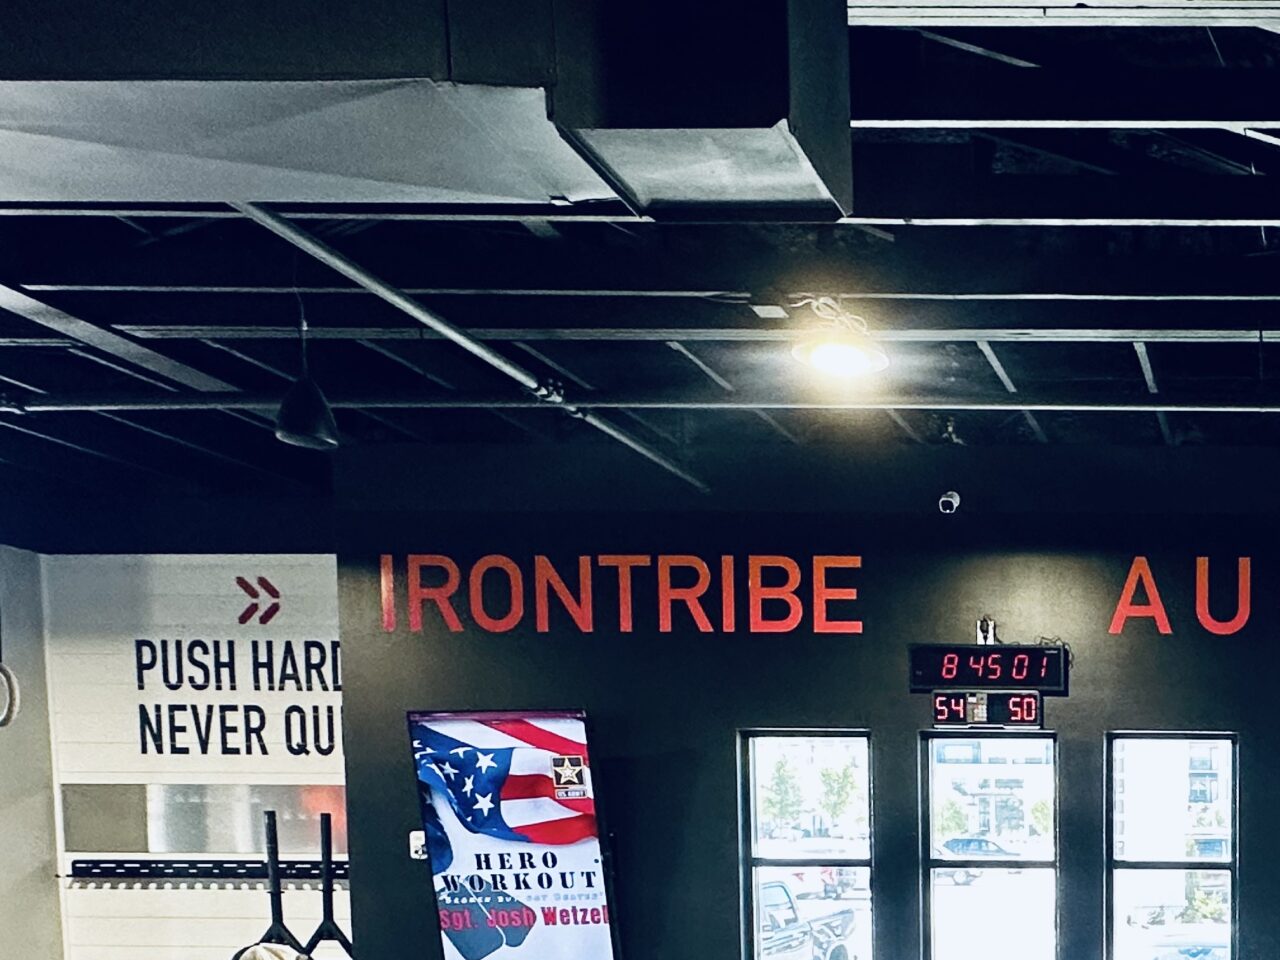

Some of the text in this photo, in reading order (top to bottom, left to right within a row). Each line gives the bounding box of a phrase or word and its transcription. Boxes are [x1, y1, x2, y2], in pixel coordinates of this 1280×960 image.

[380, 555, 863, 634] IRONTRIBE
[135, 639, 237, 690] PUSH
[935, 696, 1036, 721] 54 50
[139, 704, 342, 756] NEVER QU
[475, 851, 558, 871] HERO
[441, 871, 597, 893] WORKOUT
[439, 904, 610, 929] Sgt. Josh Wetzel
